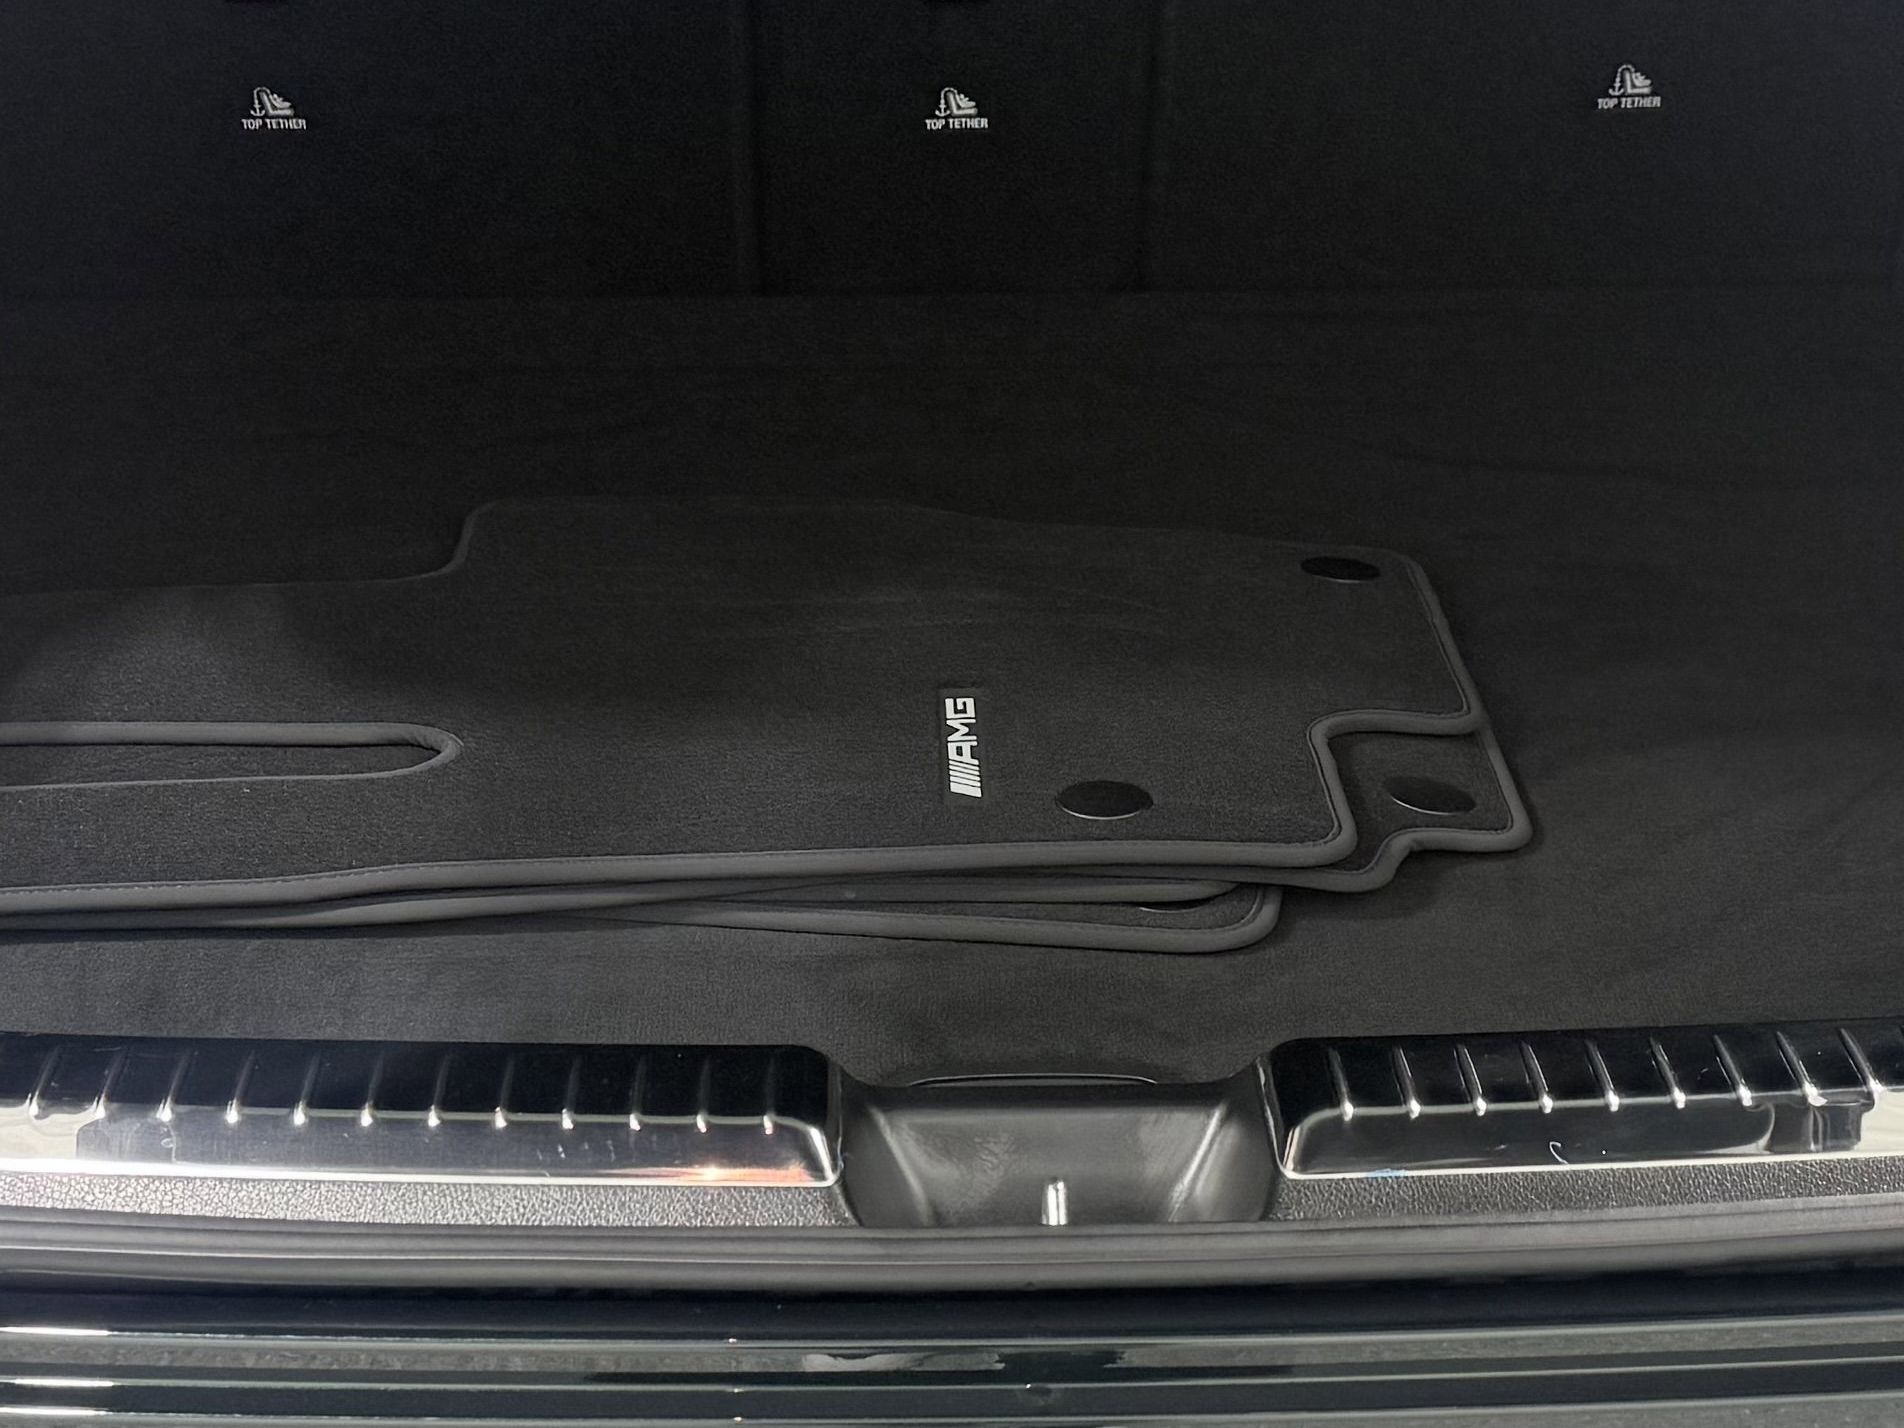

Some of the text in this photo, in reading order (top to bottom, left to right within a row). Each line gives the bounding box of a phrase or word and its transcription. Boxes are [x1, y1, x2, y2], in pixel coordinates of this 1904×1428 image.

[1597, 95, 1662, 110] TOP TETHER
[241, 118, 307, 130] TOP TETHER
[925, 117, 989, 130] TOP TETHER
[944, 697, 980, 766] AMG
